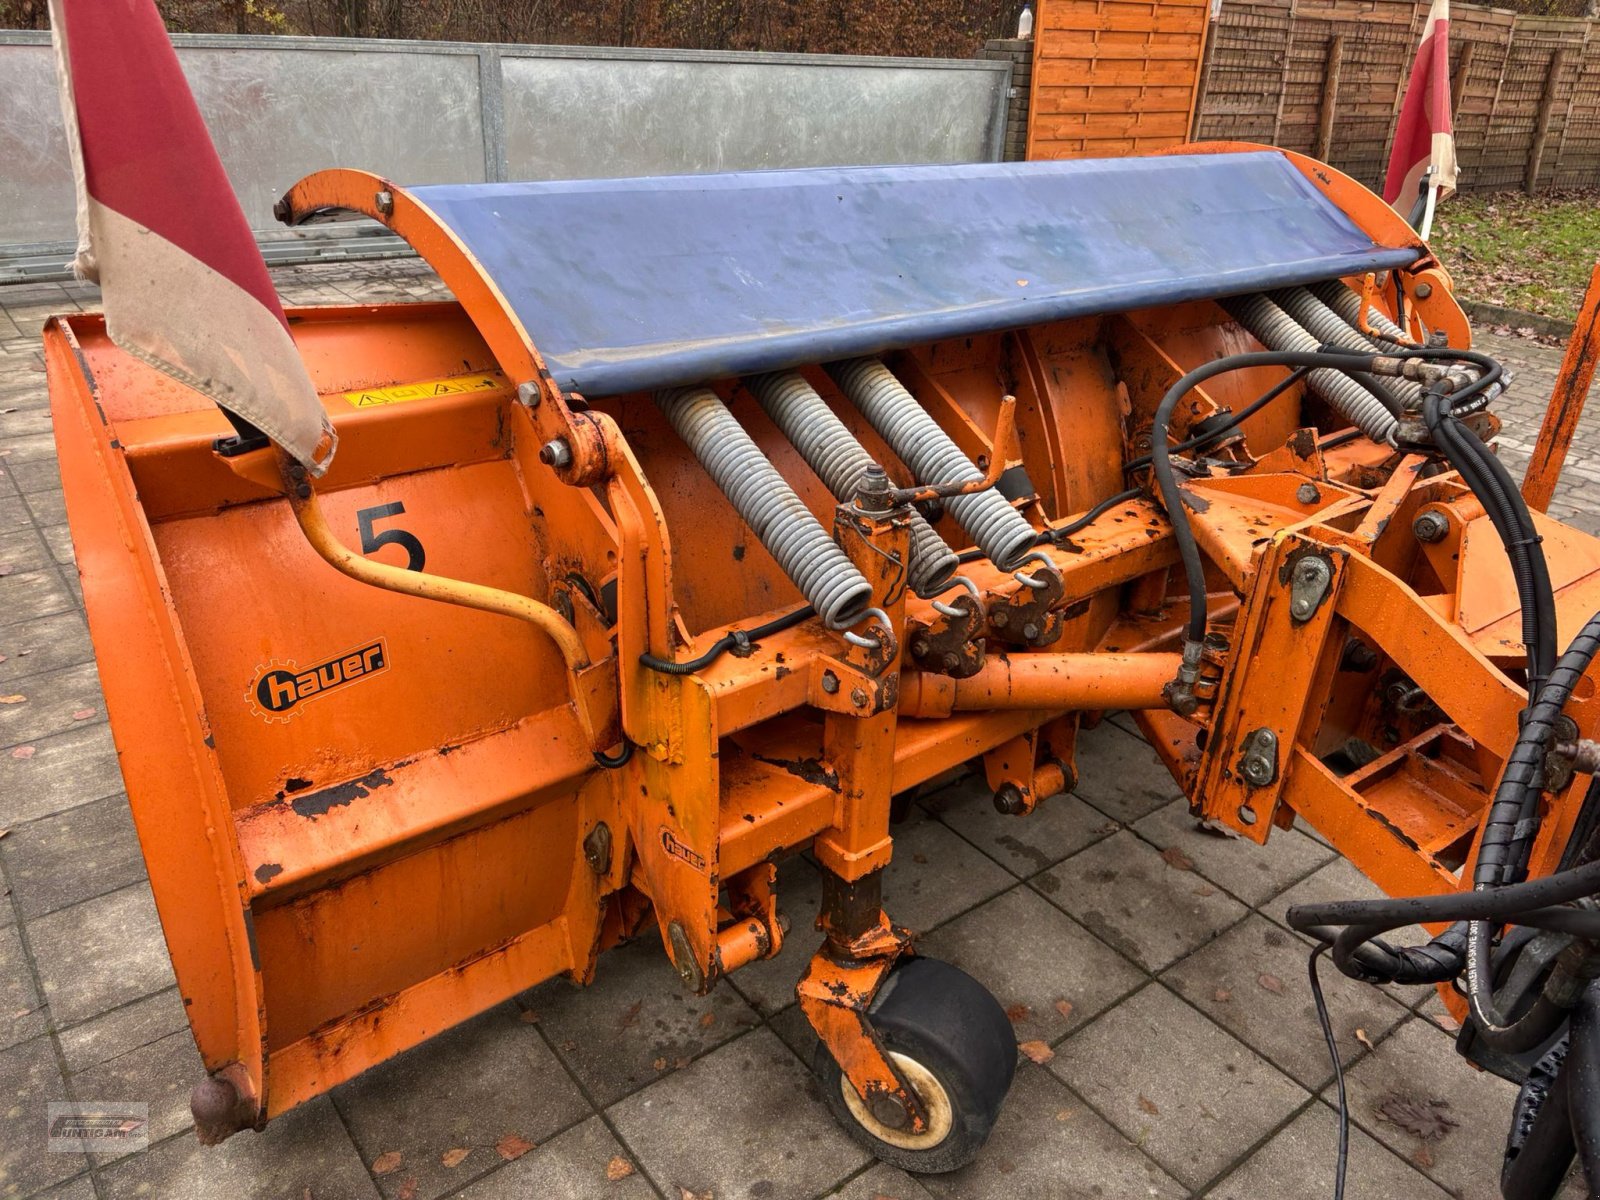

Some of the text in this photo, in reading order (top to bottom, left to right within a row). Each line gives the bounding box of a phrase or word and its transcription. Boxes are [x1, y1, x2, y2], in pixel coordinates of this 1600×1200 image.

[357, 501, 426, 573] 5
[267, 646, 381, 709] hauer
[1468, 969, 1479, 995] PARKER
